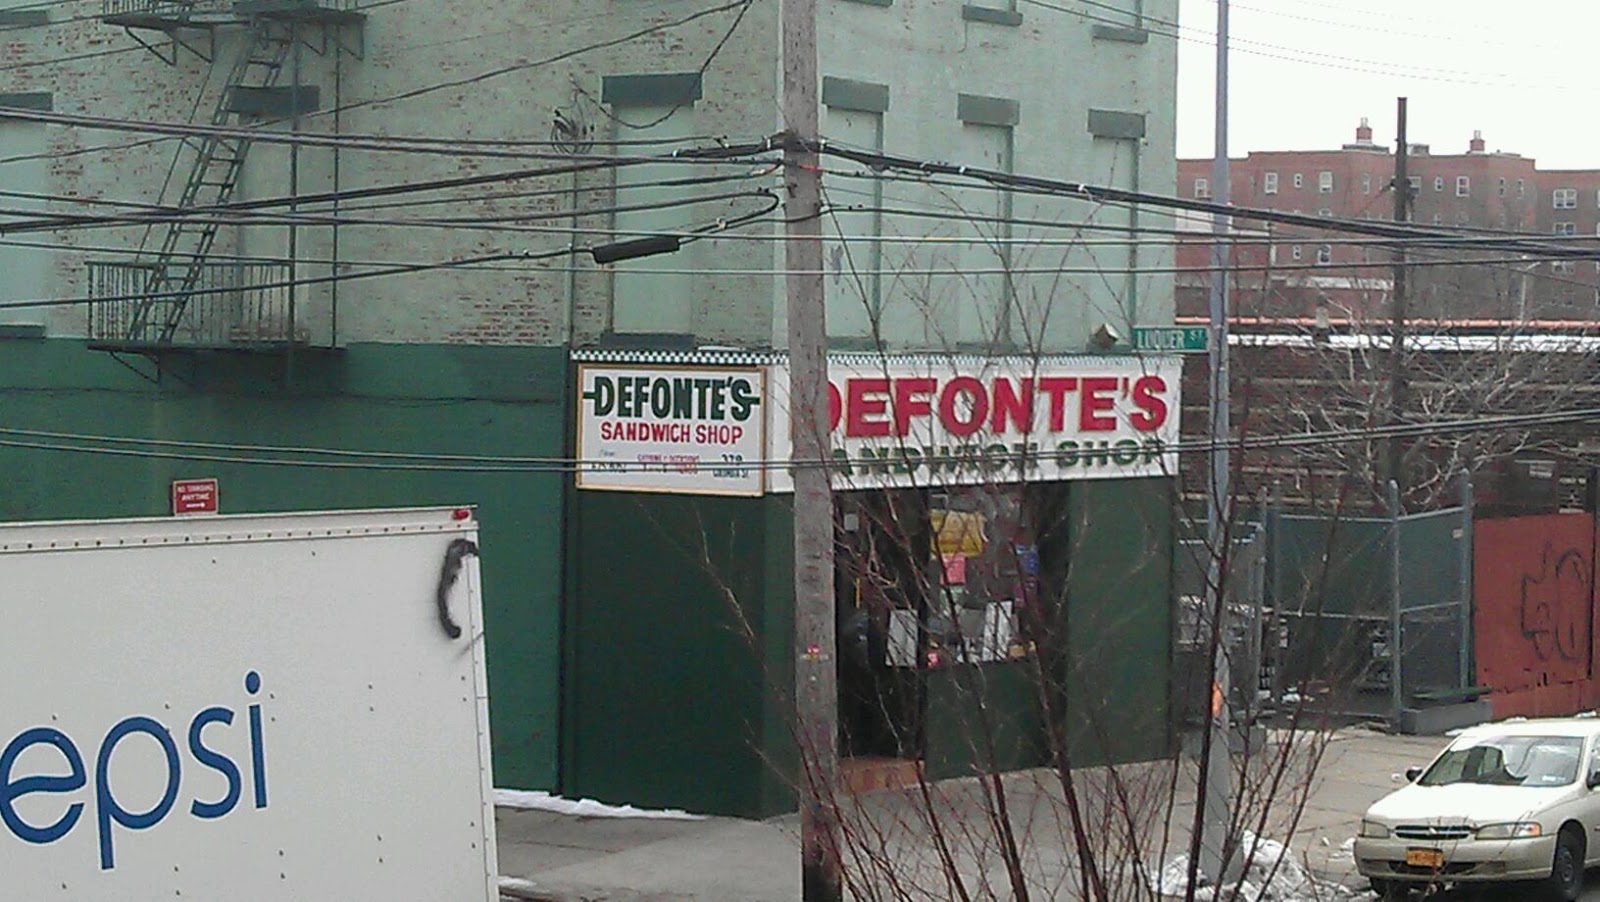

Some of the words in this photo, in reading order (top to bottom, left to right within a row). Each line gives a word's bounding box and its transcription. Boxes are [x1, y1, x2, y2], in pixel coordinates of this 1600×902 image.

[1137, 329, 1185, 352] LUQUER
[593, 376, 752, 421] DEFONTE'S
[601, 421, 690, 443] SANDWICH
[695, 424, 743, 445] SHOP
[831, 443, 1038, 476] ANDWICH
[1058, 438, 1166, 469] SHOP
[0, 671, 268, 870] epsi
